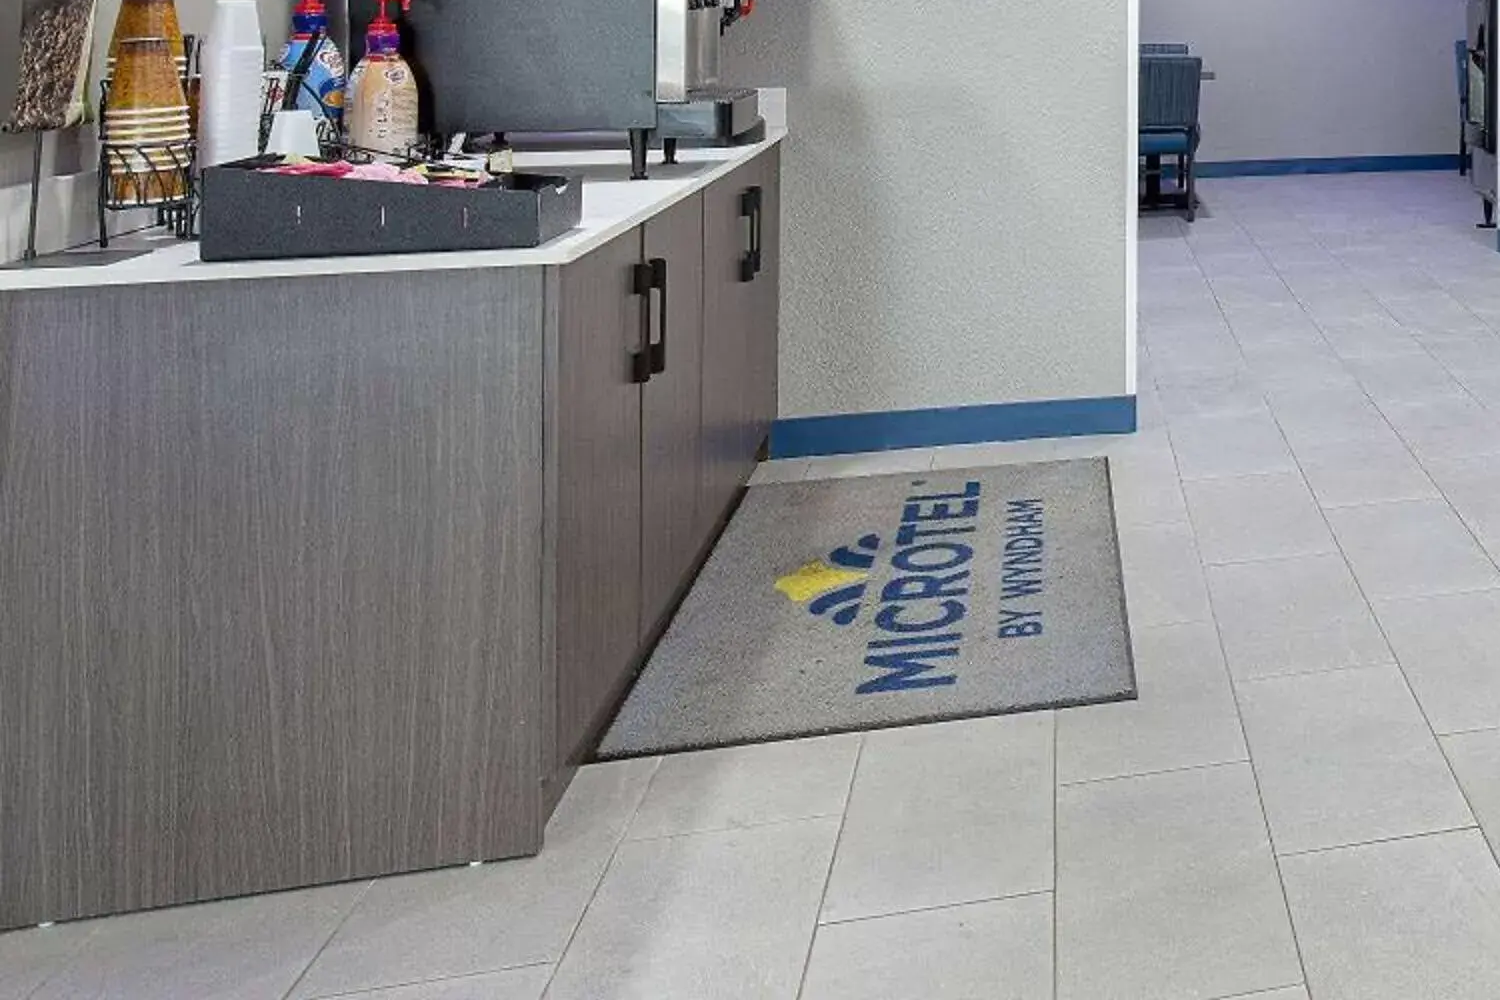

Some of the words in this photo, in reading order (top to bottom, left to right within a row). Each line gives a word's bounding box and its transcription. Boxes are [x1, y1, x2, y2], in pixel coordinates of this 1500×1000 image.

[855, 480, 981, 695] MICROTEL
[999, 498, 1044, 601] WYNDHAM
[997, 608, 1043, 639] BY
